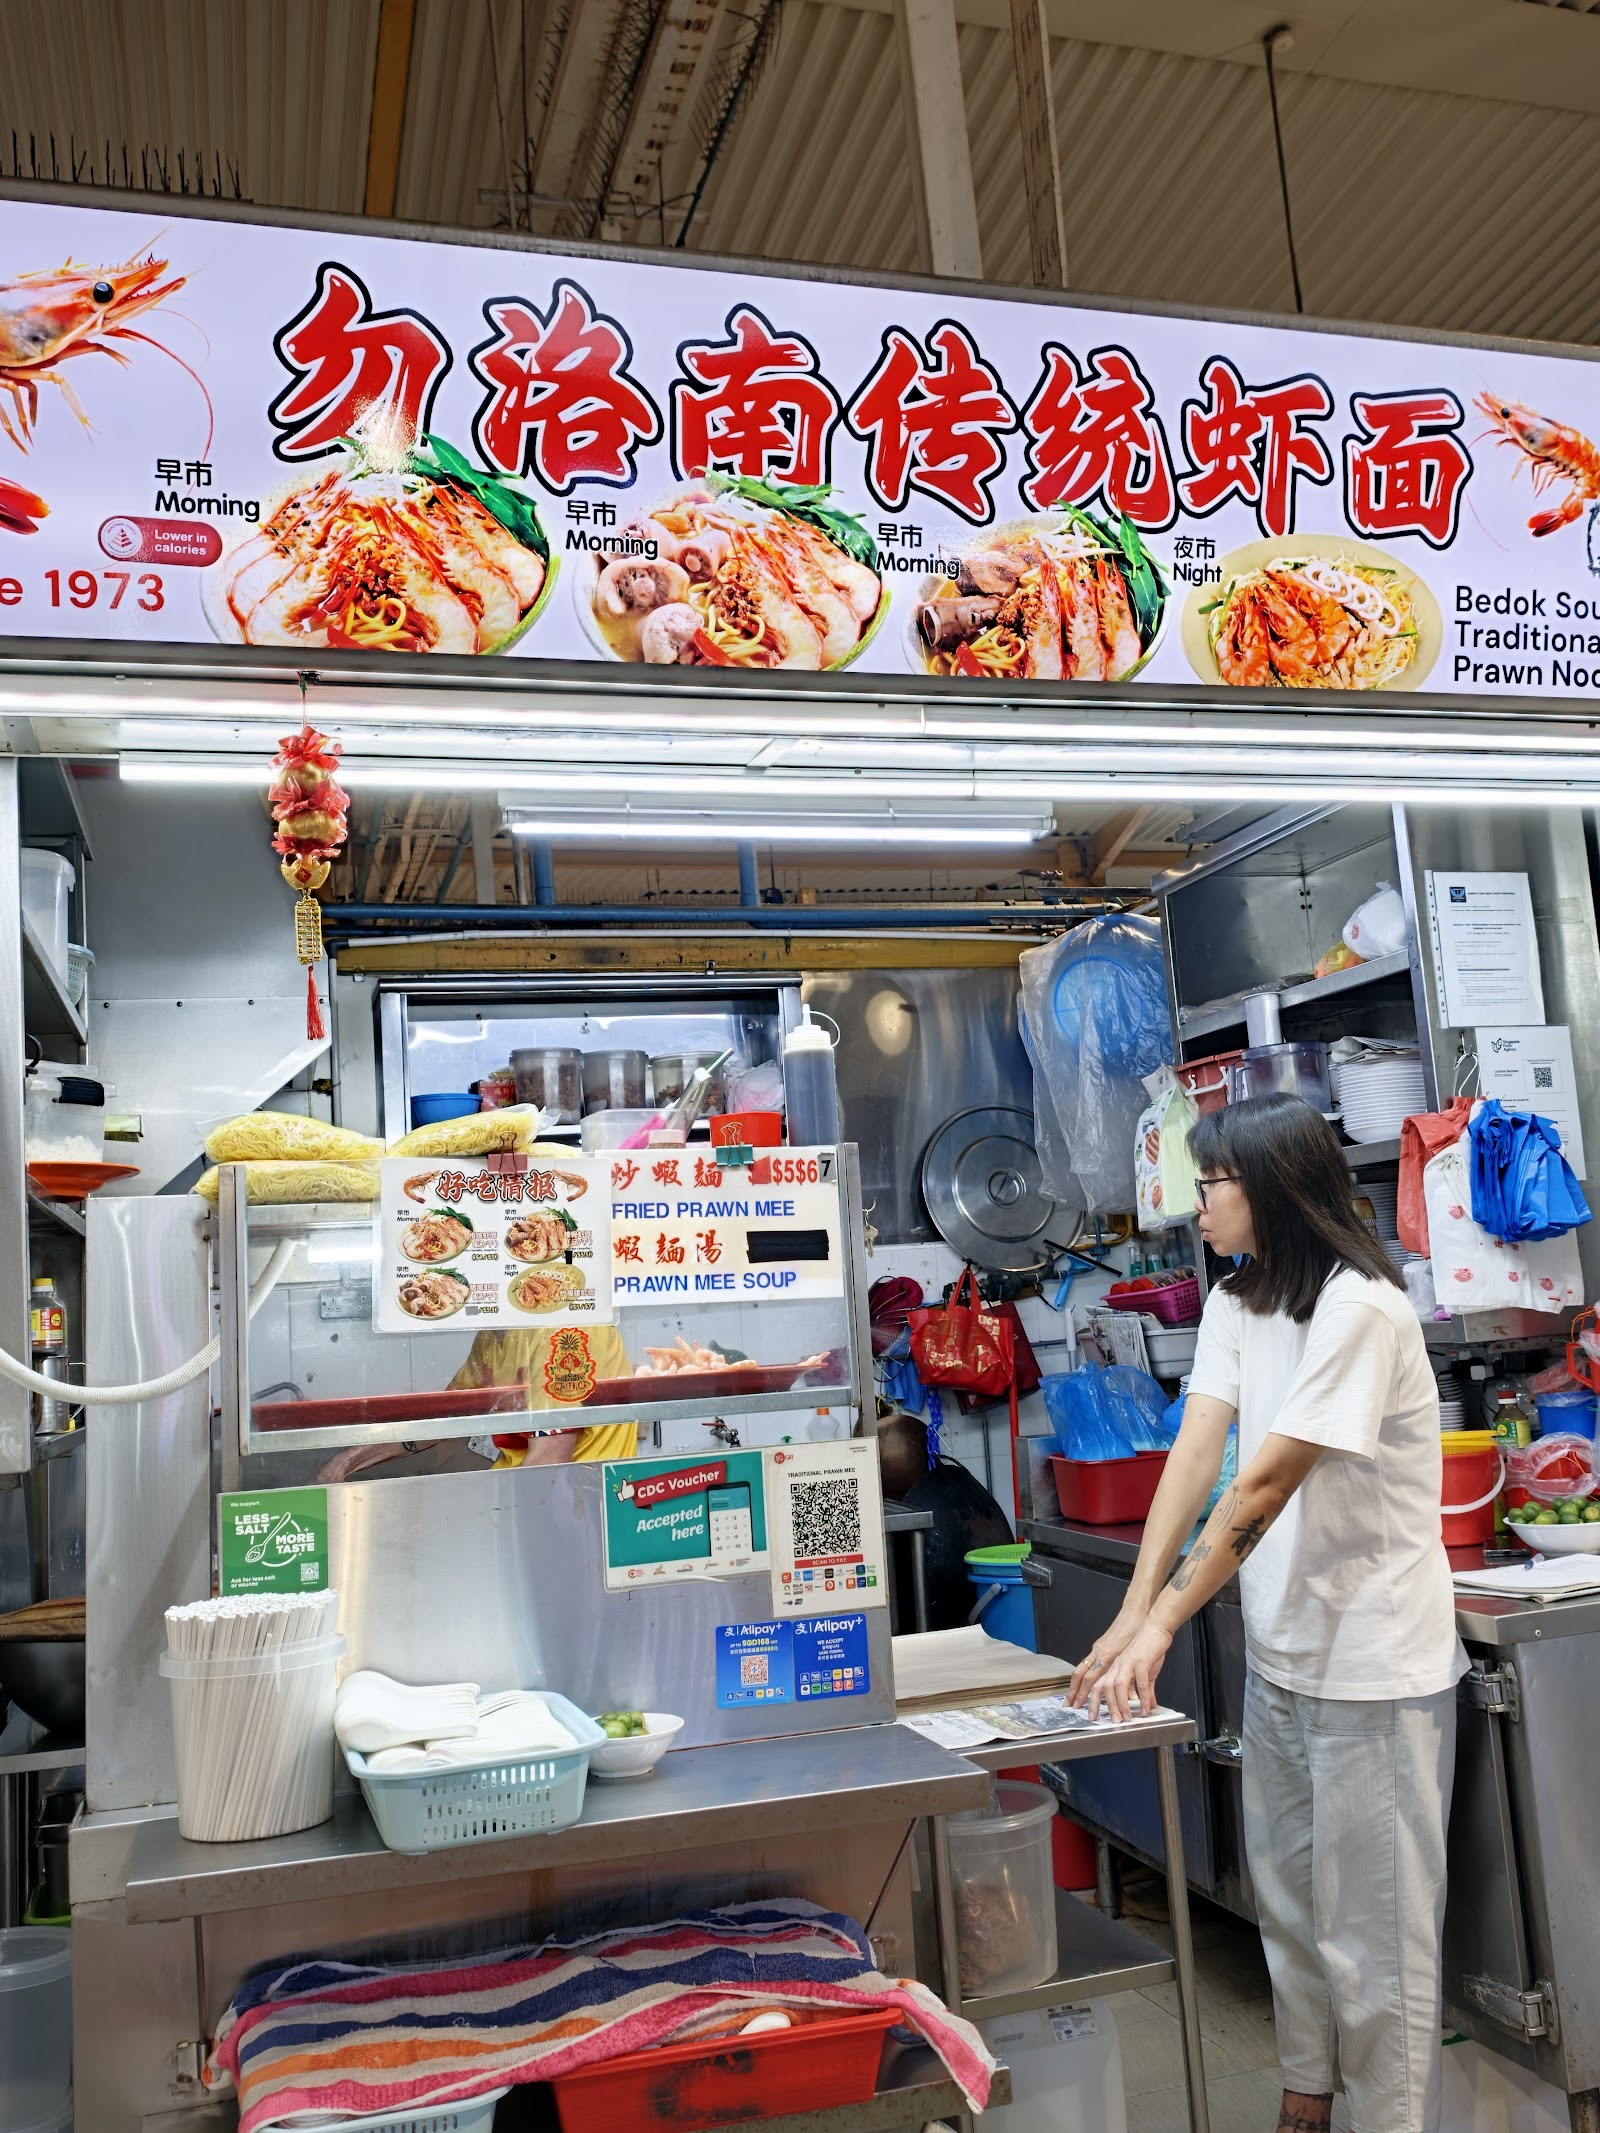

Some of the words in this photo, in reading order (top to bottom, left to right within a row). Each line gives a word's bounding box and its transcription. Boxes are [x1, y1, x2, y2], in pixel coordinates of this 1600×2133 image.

[269, 261, 1474, 550] 勿洛南传统虾面
[155, 459, 212, 487] 早市
[155, 491, 260, 523] Morning
[565, 500, 616, 527] 早市
[154, 529, 193, 542] Lower
[196, 533, 208, 543] in
[565, 530, 658, 560] Morning
[877, 523, 922, 548] 早市
[1174, 535, 1216, 560] 夜市
[154, 543, 207, 555] calories
[875, 551, 960, 580] Morning
[1173, 563, 1222, 587] Night
[44, 569, 165, 612] 1973
[1456, 585, 1547, 617] Bedok
[1454, 620, 1600, 654] Traditiona
[1454, 655, 1543, 685] Prawn
[435, 1169, 559, 1204] 好吃情报
[612, 1203, 670, 1219] FRIED
[677, 1201, 749, 1218] PRAWN
[755, 1200, 795, 1216] MEE
[614, 1275, 688, 1293] PRAWN
[695, 1273, 735, 1290] MEE
[743, 1271, 796, 1288] SOUP
[637, 1482, 665, 1498] CDC
[668, 1470, 720, 1490] Voucher
[787, 1470, 822, 1478] TRADITIONAL
[234, 1513, 270, 1525] LESS
[235, 1523, 269, 1536] SALT
[636, 1504, 703, 1533] Accepted
[276, 1532, 315, 1545] MORE
[672, 1524, 704, 1541] here
[276, 1543, 315, 1554] TASTE
[742, 1638, 769, 1647] SGD168
